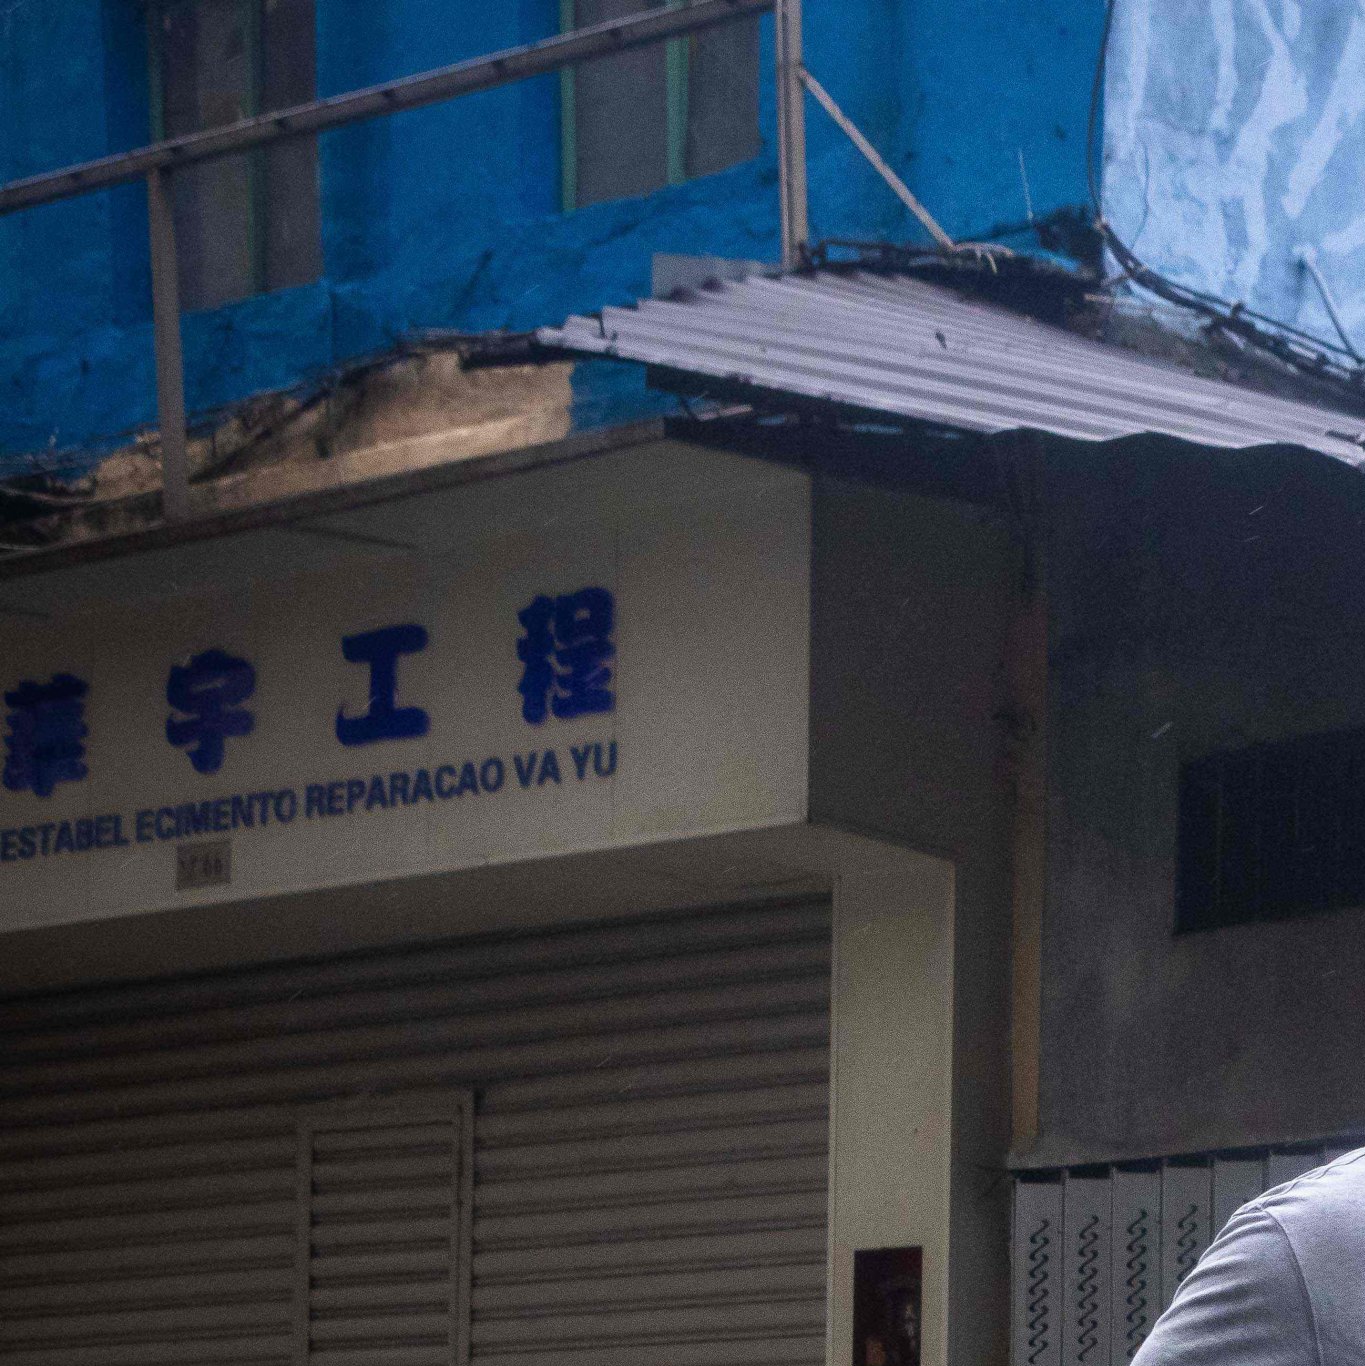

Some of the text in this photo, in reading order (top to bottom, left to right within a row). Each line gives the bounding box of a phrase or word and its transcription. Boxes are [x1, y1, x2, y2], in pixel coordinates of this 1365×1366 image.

[305, 756, 505, 820] REPARACAO
[513, 749, 562, 789] VA
[571, 740, 618, 781] YU
